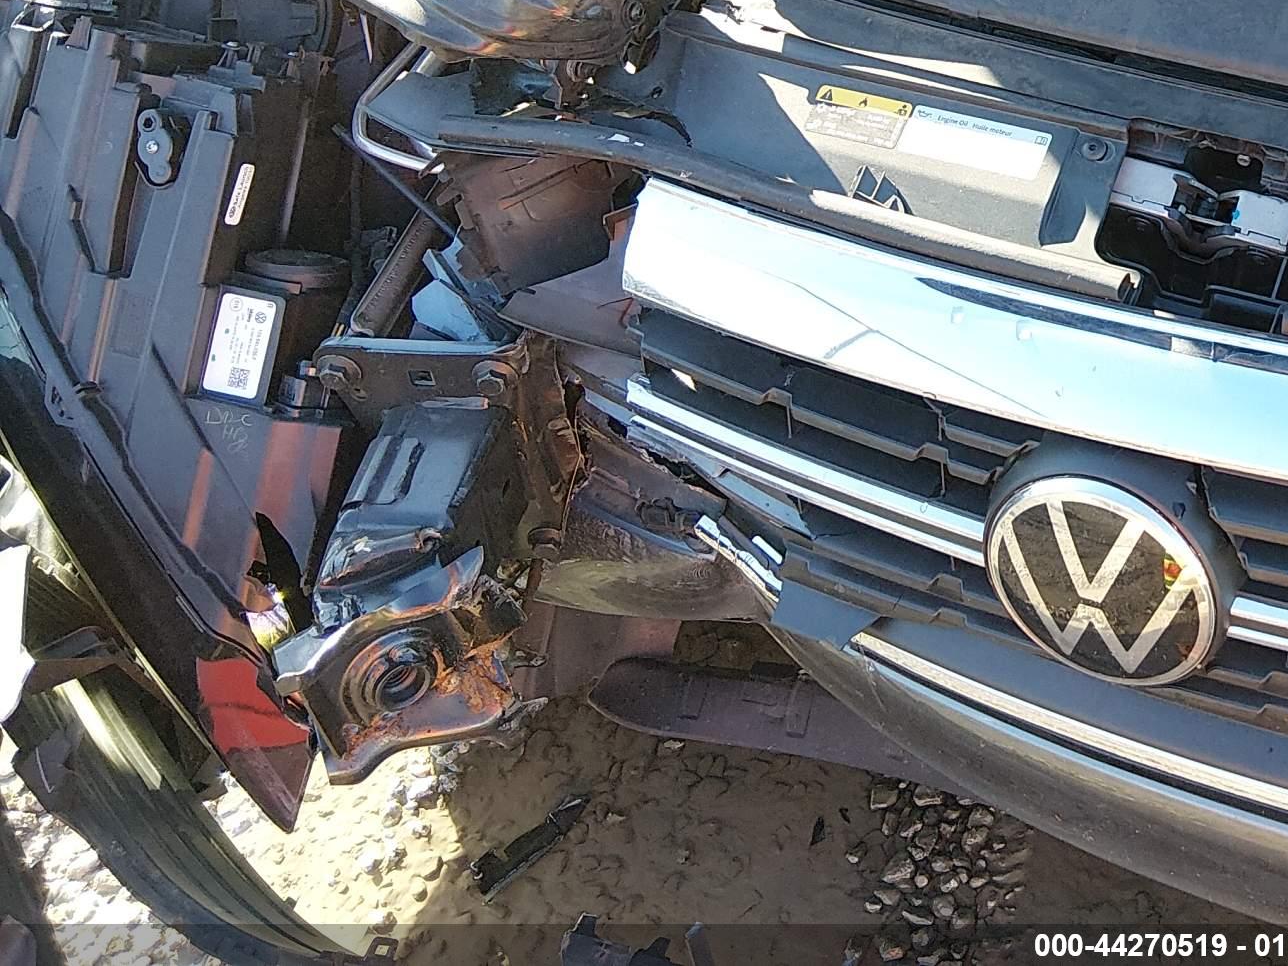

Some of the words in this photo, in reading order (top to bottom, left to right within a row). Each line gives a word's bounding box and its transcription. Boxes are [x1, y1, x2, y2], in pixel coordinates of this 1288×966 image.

[937, 114, 958, 126] Engine
[958, 119, 969, 127] Oil
[989, 127, 1012, 137] moteur
